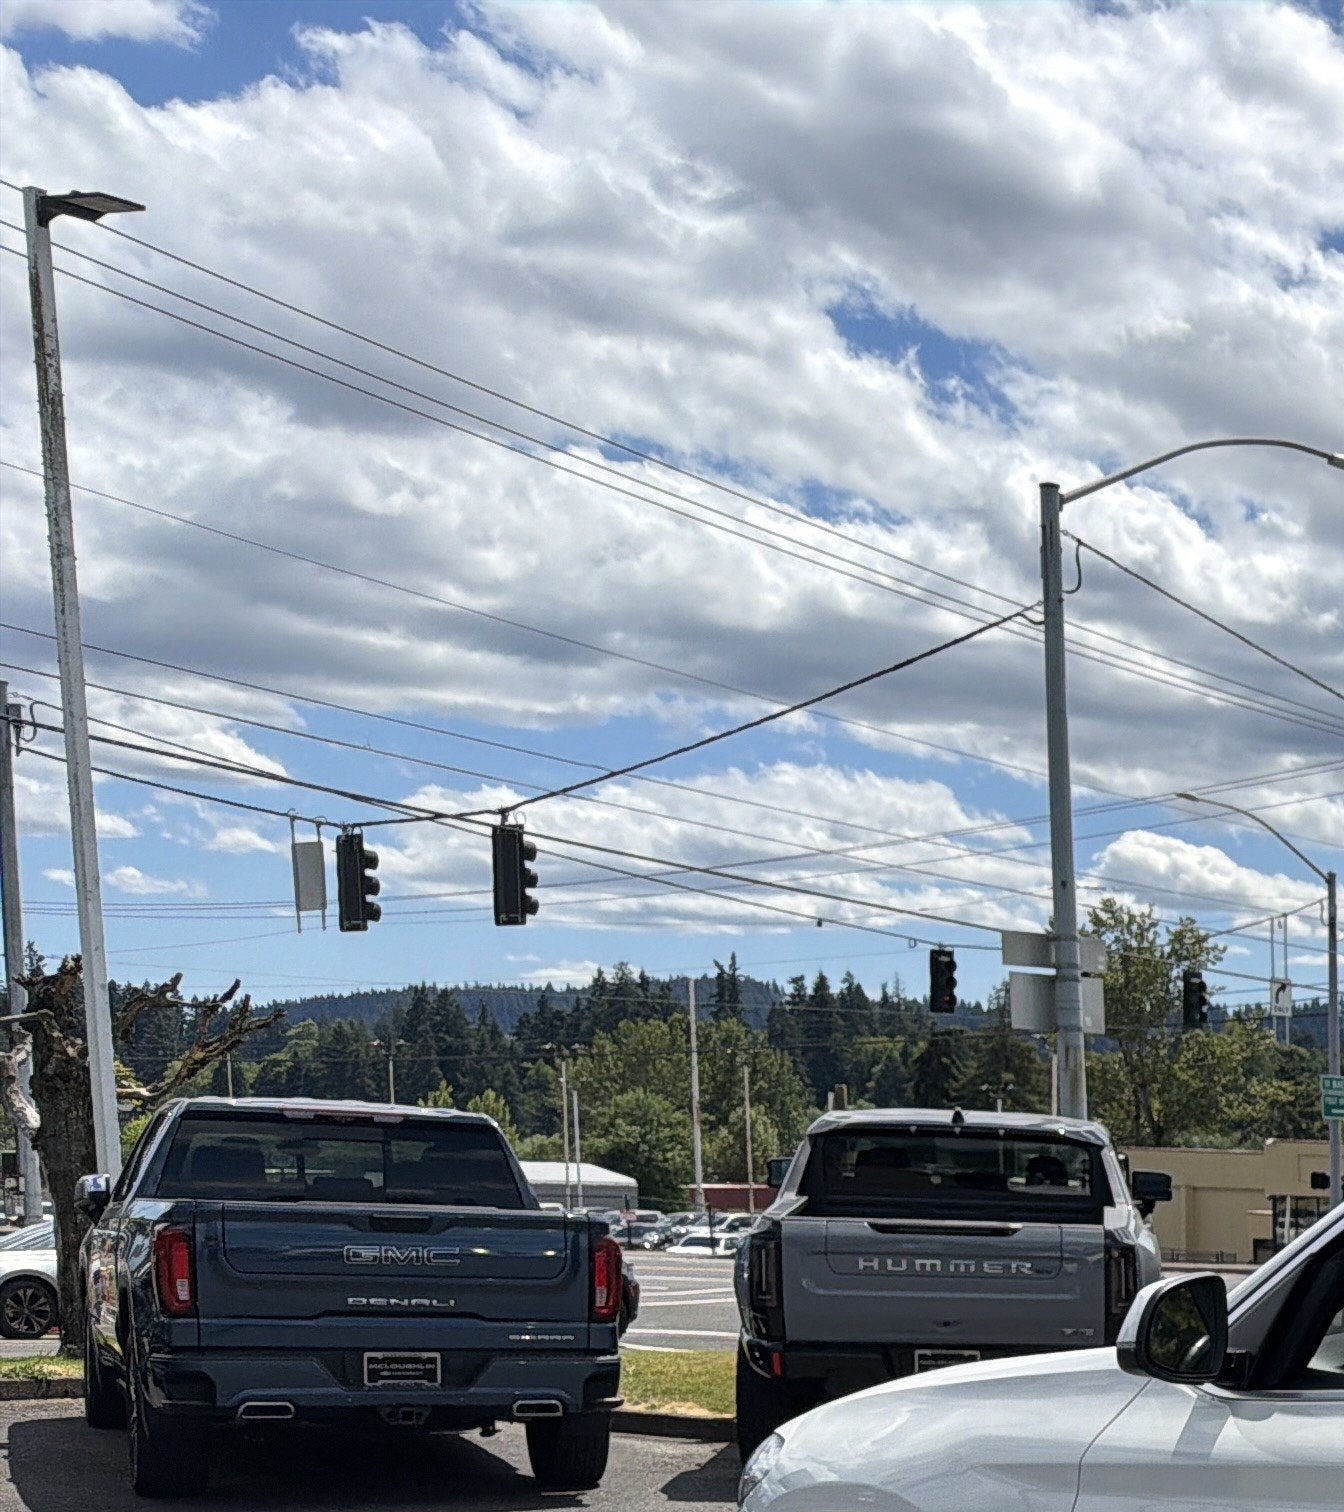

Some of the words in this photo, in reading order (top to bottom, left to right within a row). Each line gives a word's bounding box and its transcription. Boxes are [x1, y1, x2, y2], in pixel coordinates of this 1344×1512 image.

[343, 1245, 460, 1266] GMC
[858, 1256, 1033, 1275] HUMMER
[347, 1297, 455, 1308] DENALI
